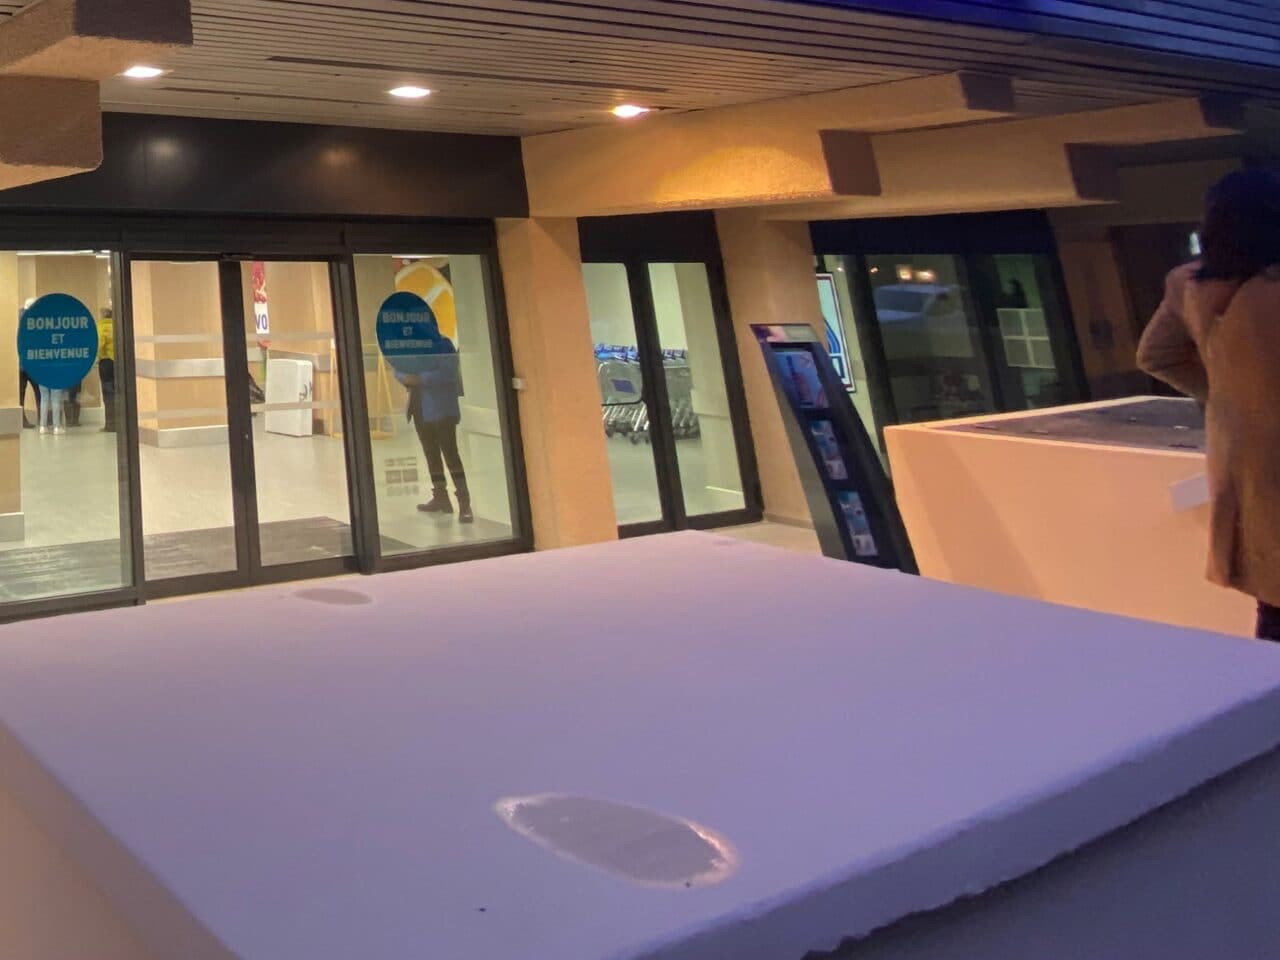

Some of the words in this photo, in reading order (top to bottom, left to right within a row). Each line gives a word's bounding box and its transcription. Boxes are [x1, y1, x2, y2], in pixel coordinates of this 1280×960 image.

[26, 316, 89, 330] BONJOUR
[51, 333, 65, 345] ET
[26, 347, 90, 360] BIENVENUE
